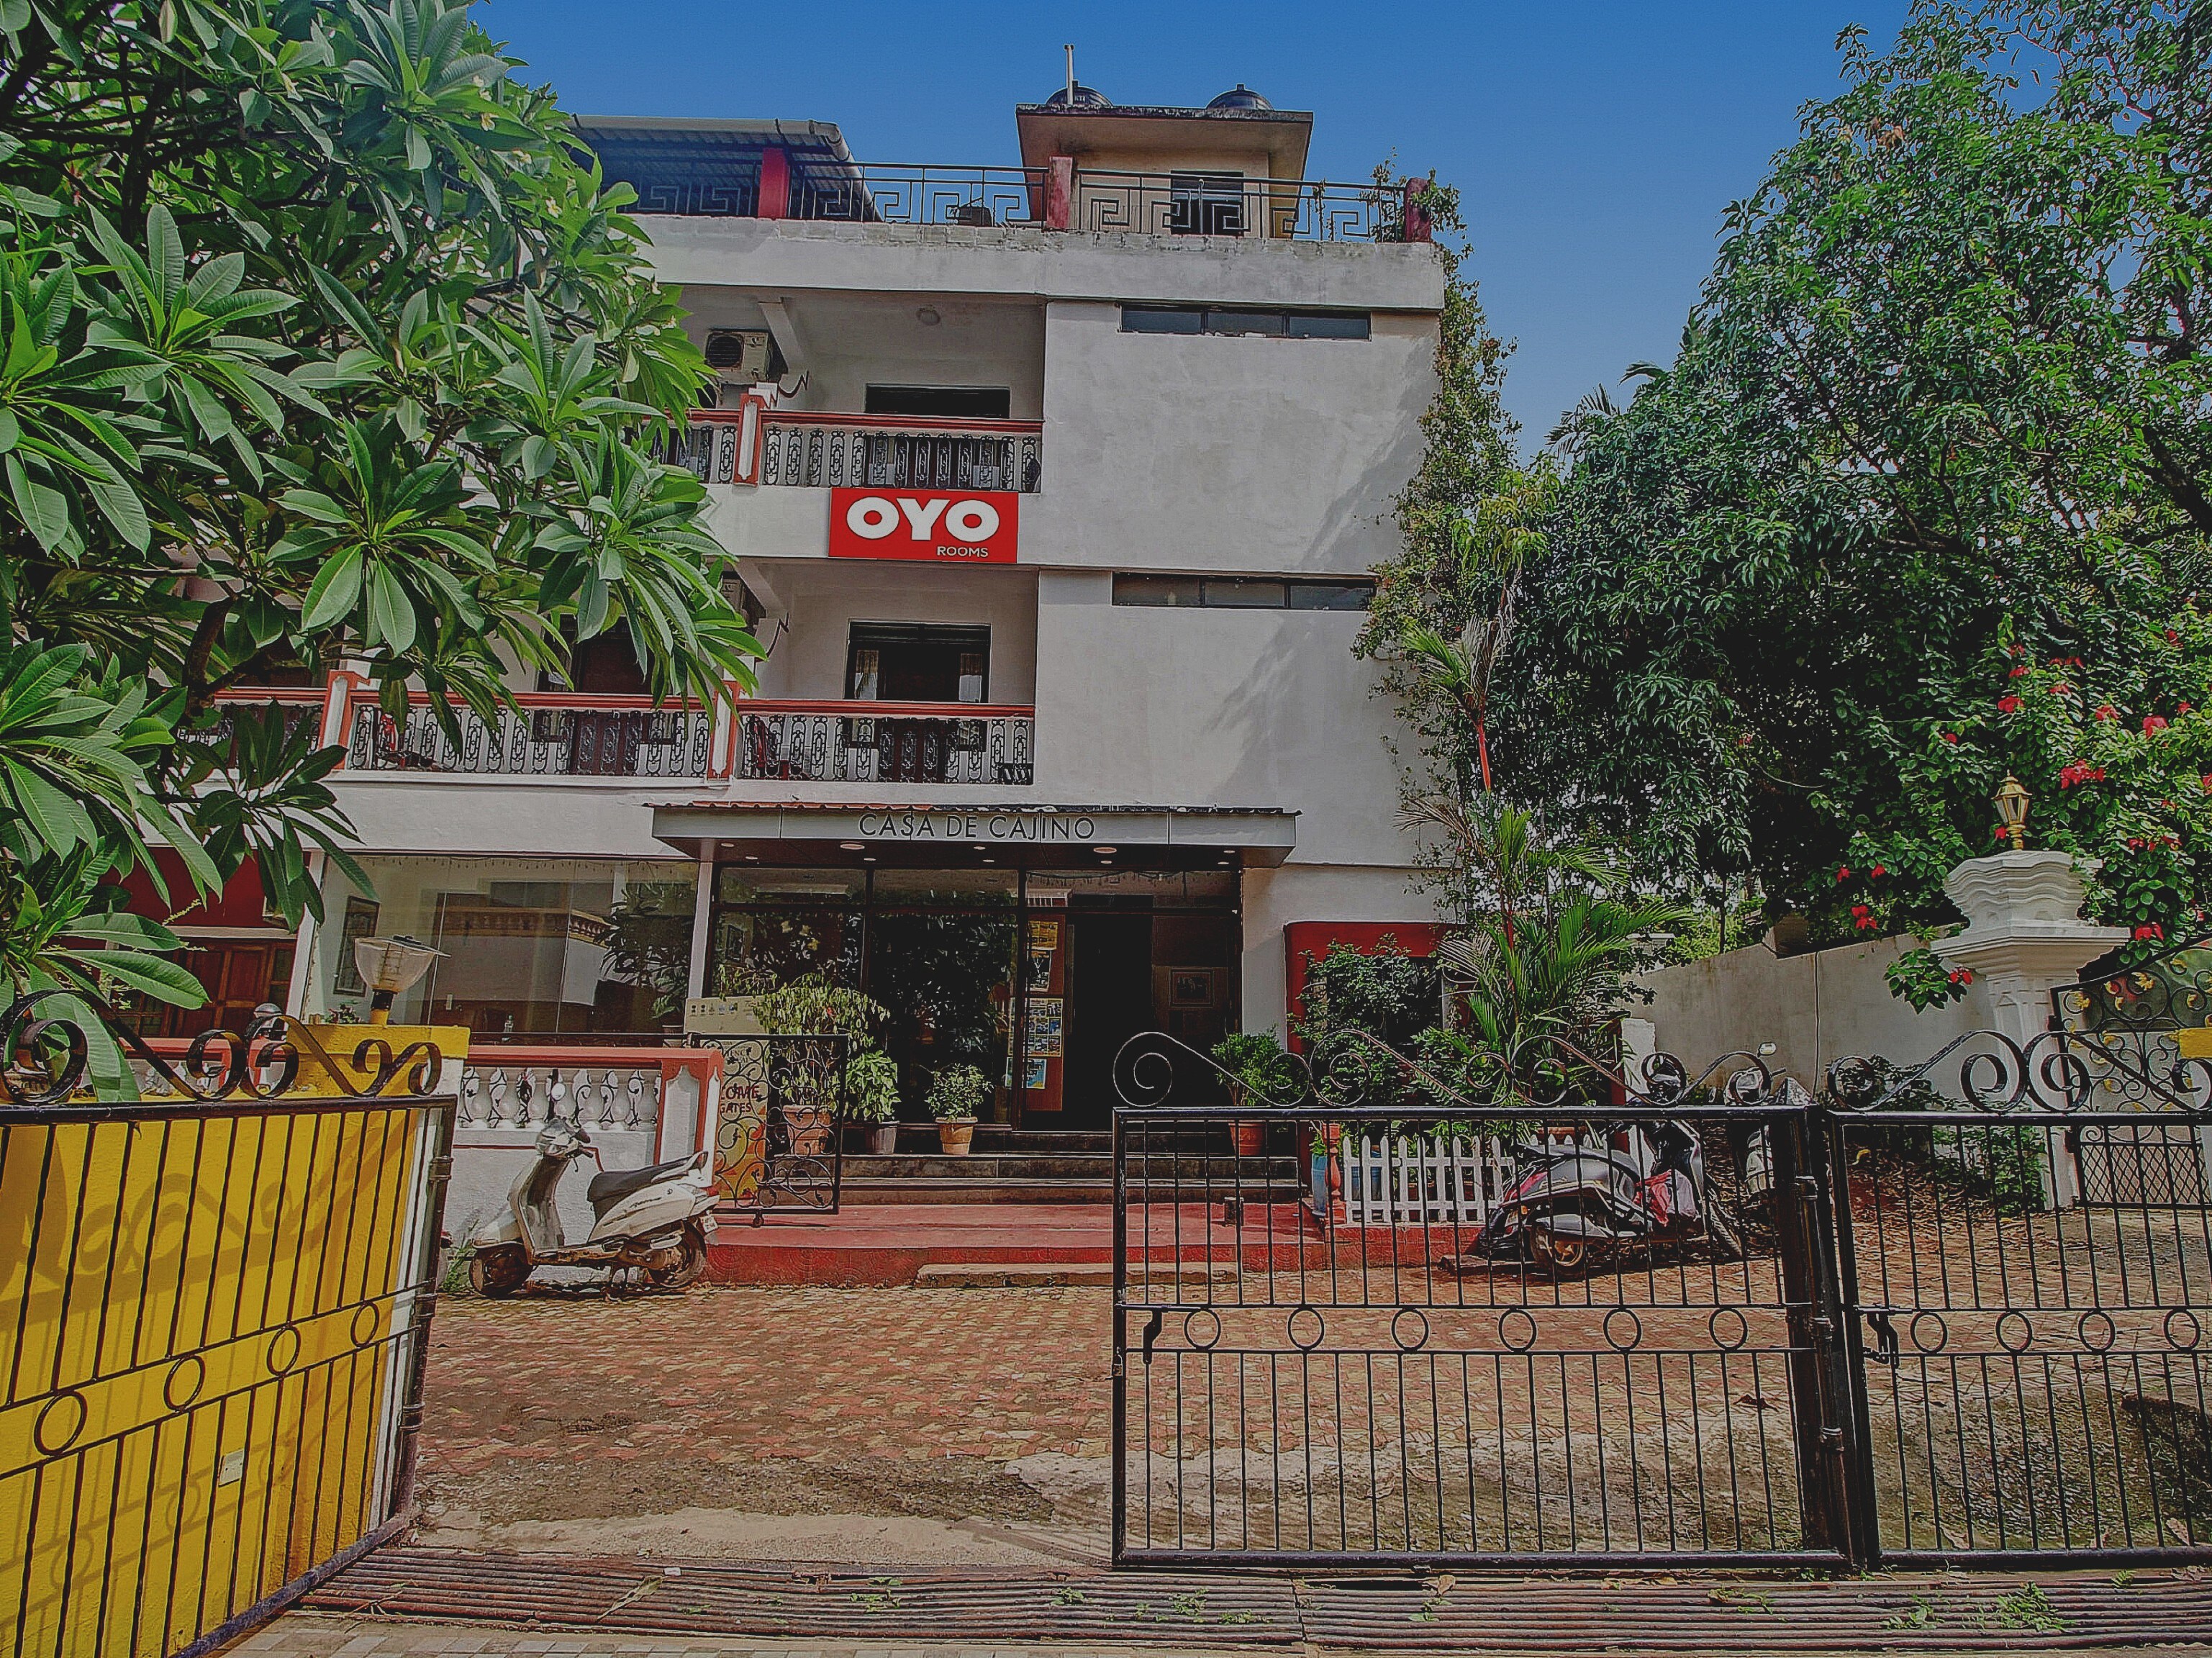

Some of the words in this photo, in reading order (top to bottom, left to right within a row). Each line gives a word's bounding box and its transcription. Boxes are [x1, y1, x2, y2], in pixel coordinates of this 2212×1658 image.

[846, 497, 1000, 543] OYO
[937, 546, 989, 558] ROOMS
[859, 814, 935, 836] CASA
[946, 816, 977, 838] DE
[989, 816, 1094, 840] CAJINO
